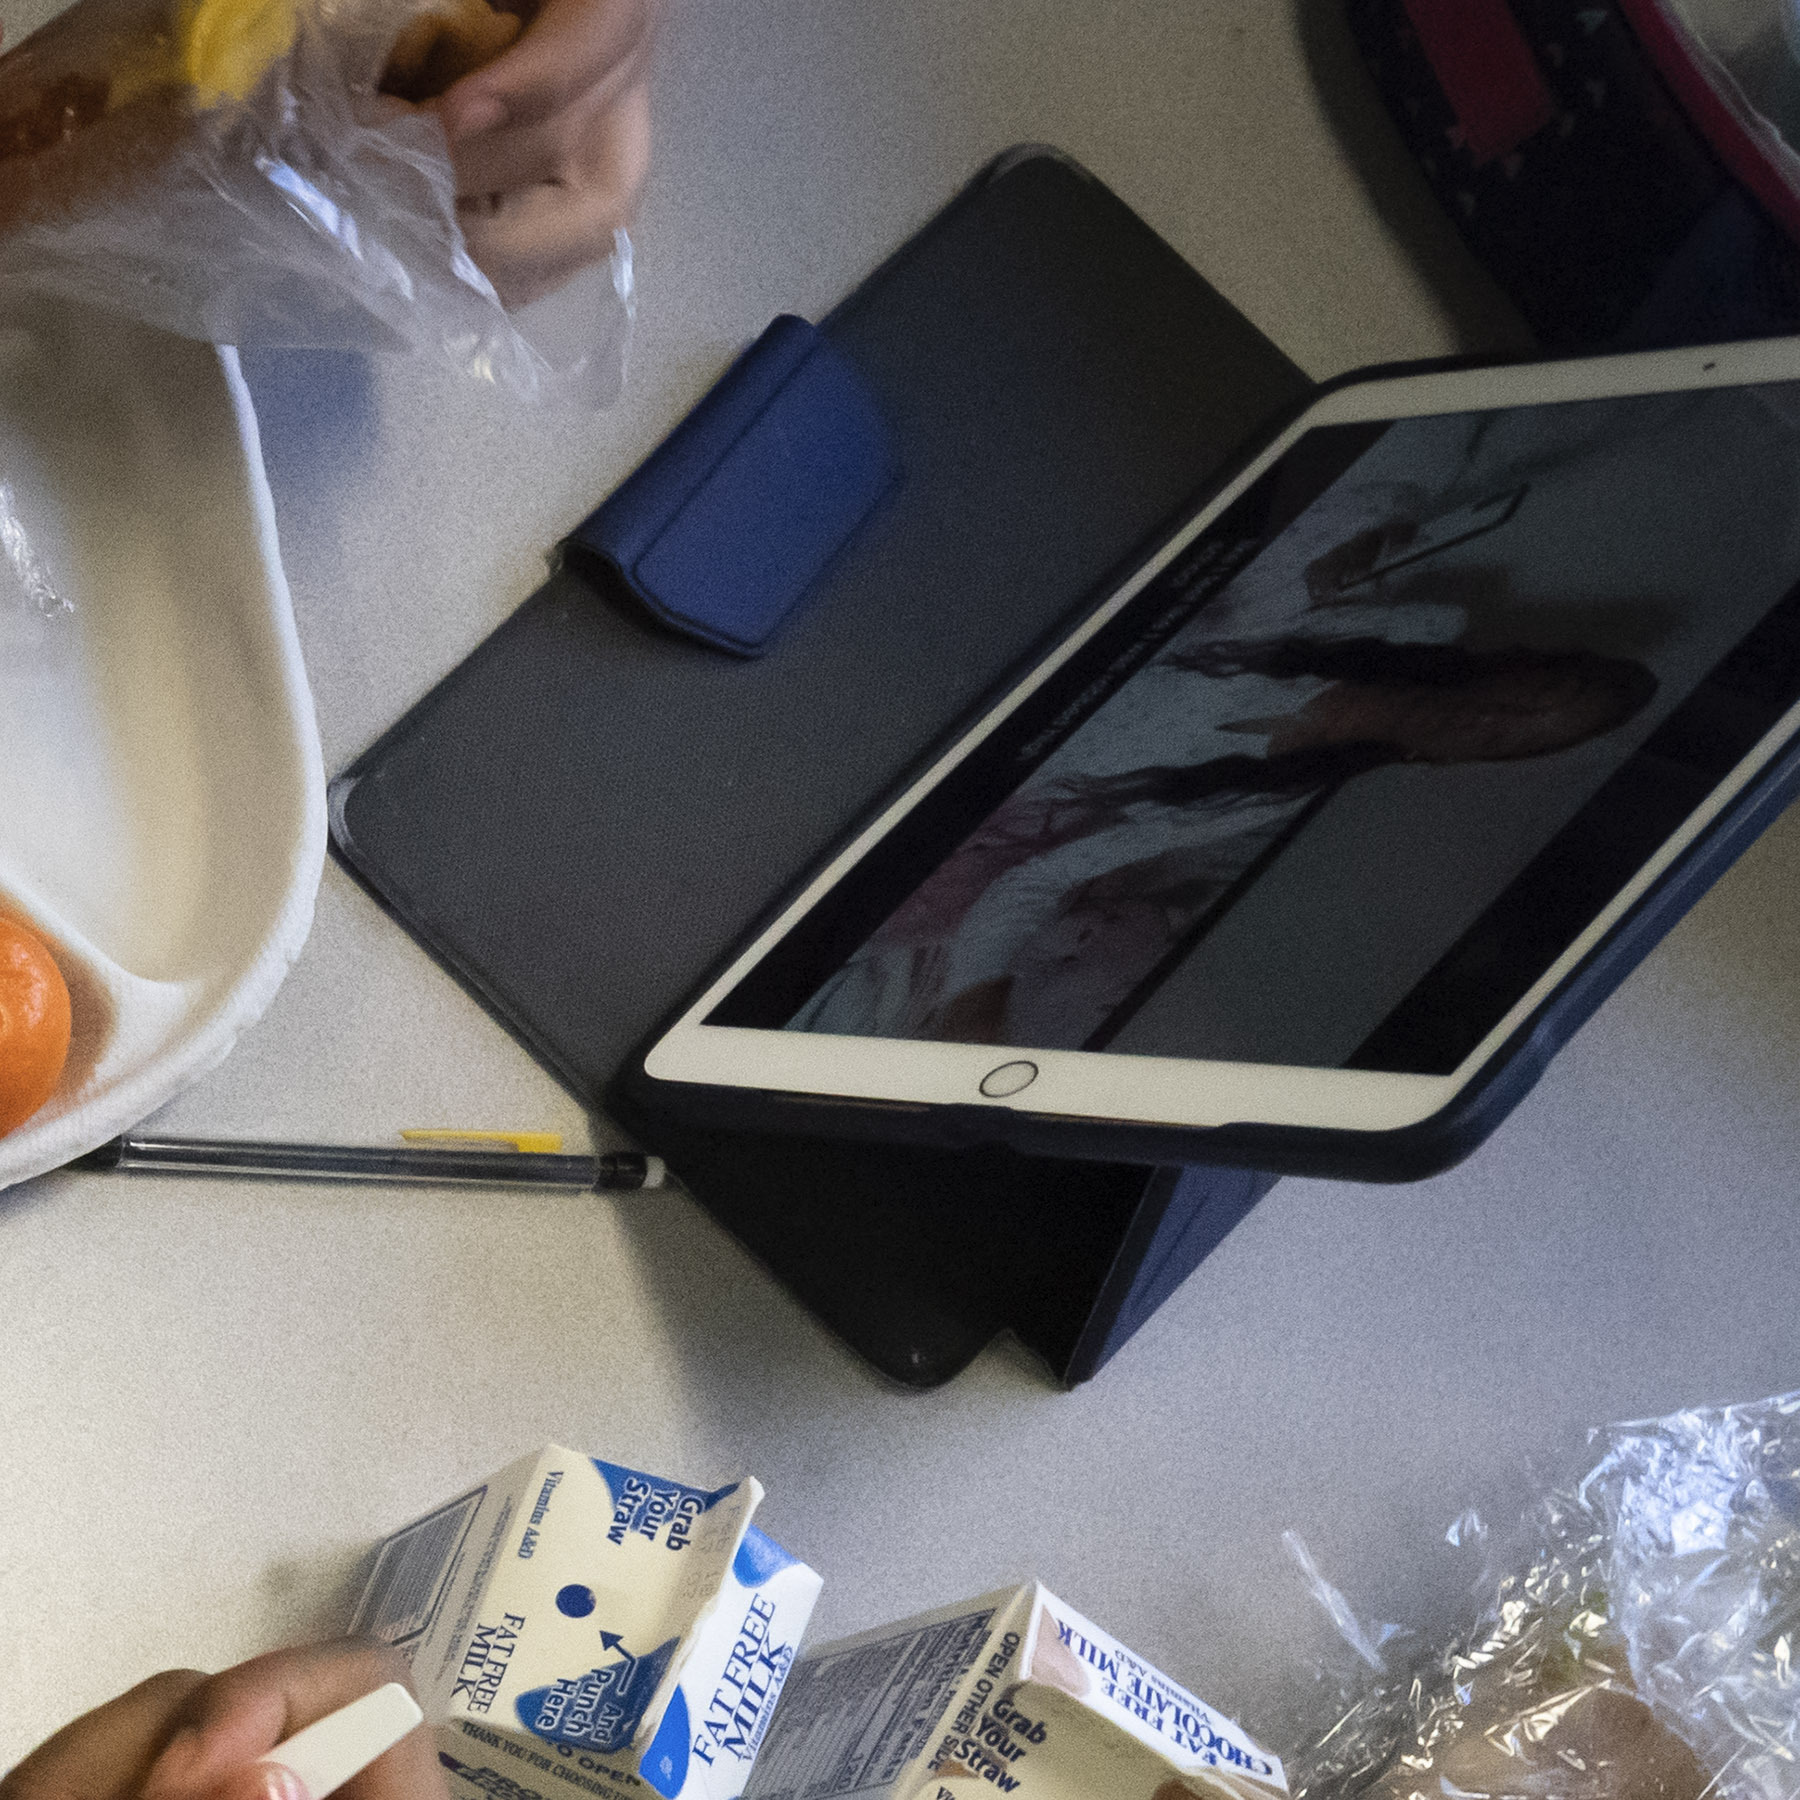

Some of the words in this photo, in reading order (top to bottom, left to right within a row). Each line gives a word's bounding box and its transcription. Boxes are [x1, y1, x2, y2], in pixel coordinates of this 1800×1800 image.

[529, 1471, 563, 1526] Vitamins
[606, 1477, 650, 1547] Straw
[639, 1488, 680, 1542] Your
[664, 1495, 704, 1552] Grab
[451, 1623, 498, 1699] MILK
[492, 1612, 526, 1658] FAT
[984, 1632, 1020, 1679] OPEN
[1057, 1618, 1120, 1682] MILK
[467, 1658, 508, 1714] FREE
[537, 1678, 579, 1728] Here
[565, 1669, 614, 1733] Punch
[692, 1688, 736, 1767] FAT
[721, 1593, 776, 1691] FREE
[721, 1631, 787, 1762] MILK
[950, 1678, 993, 1735] OTHER
[1101, 1676, 1164, 1732] FREE
[593, 1703, 622, 1742] And
[976, 1714, 1027, 1763] Your
[993, 1699, 1047, 1745] Grab
[1127, 1671, 1273, 1776] CHOCOLATE
[1170, 1729, 1217, 1766] FAT
[502, 1740, 523, 1759] YOU
[527, 1751, 550, 1771] FOR
[553, 1764, 611, 1798] CHOOSING
[578, 1757, 641, 1787] OPEN
[927, 1734, 959, 1771] SIDE
[954, 1738, 1021, 1793] Straw
